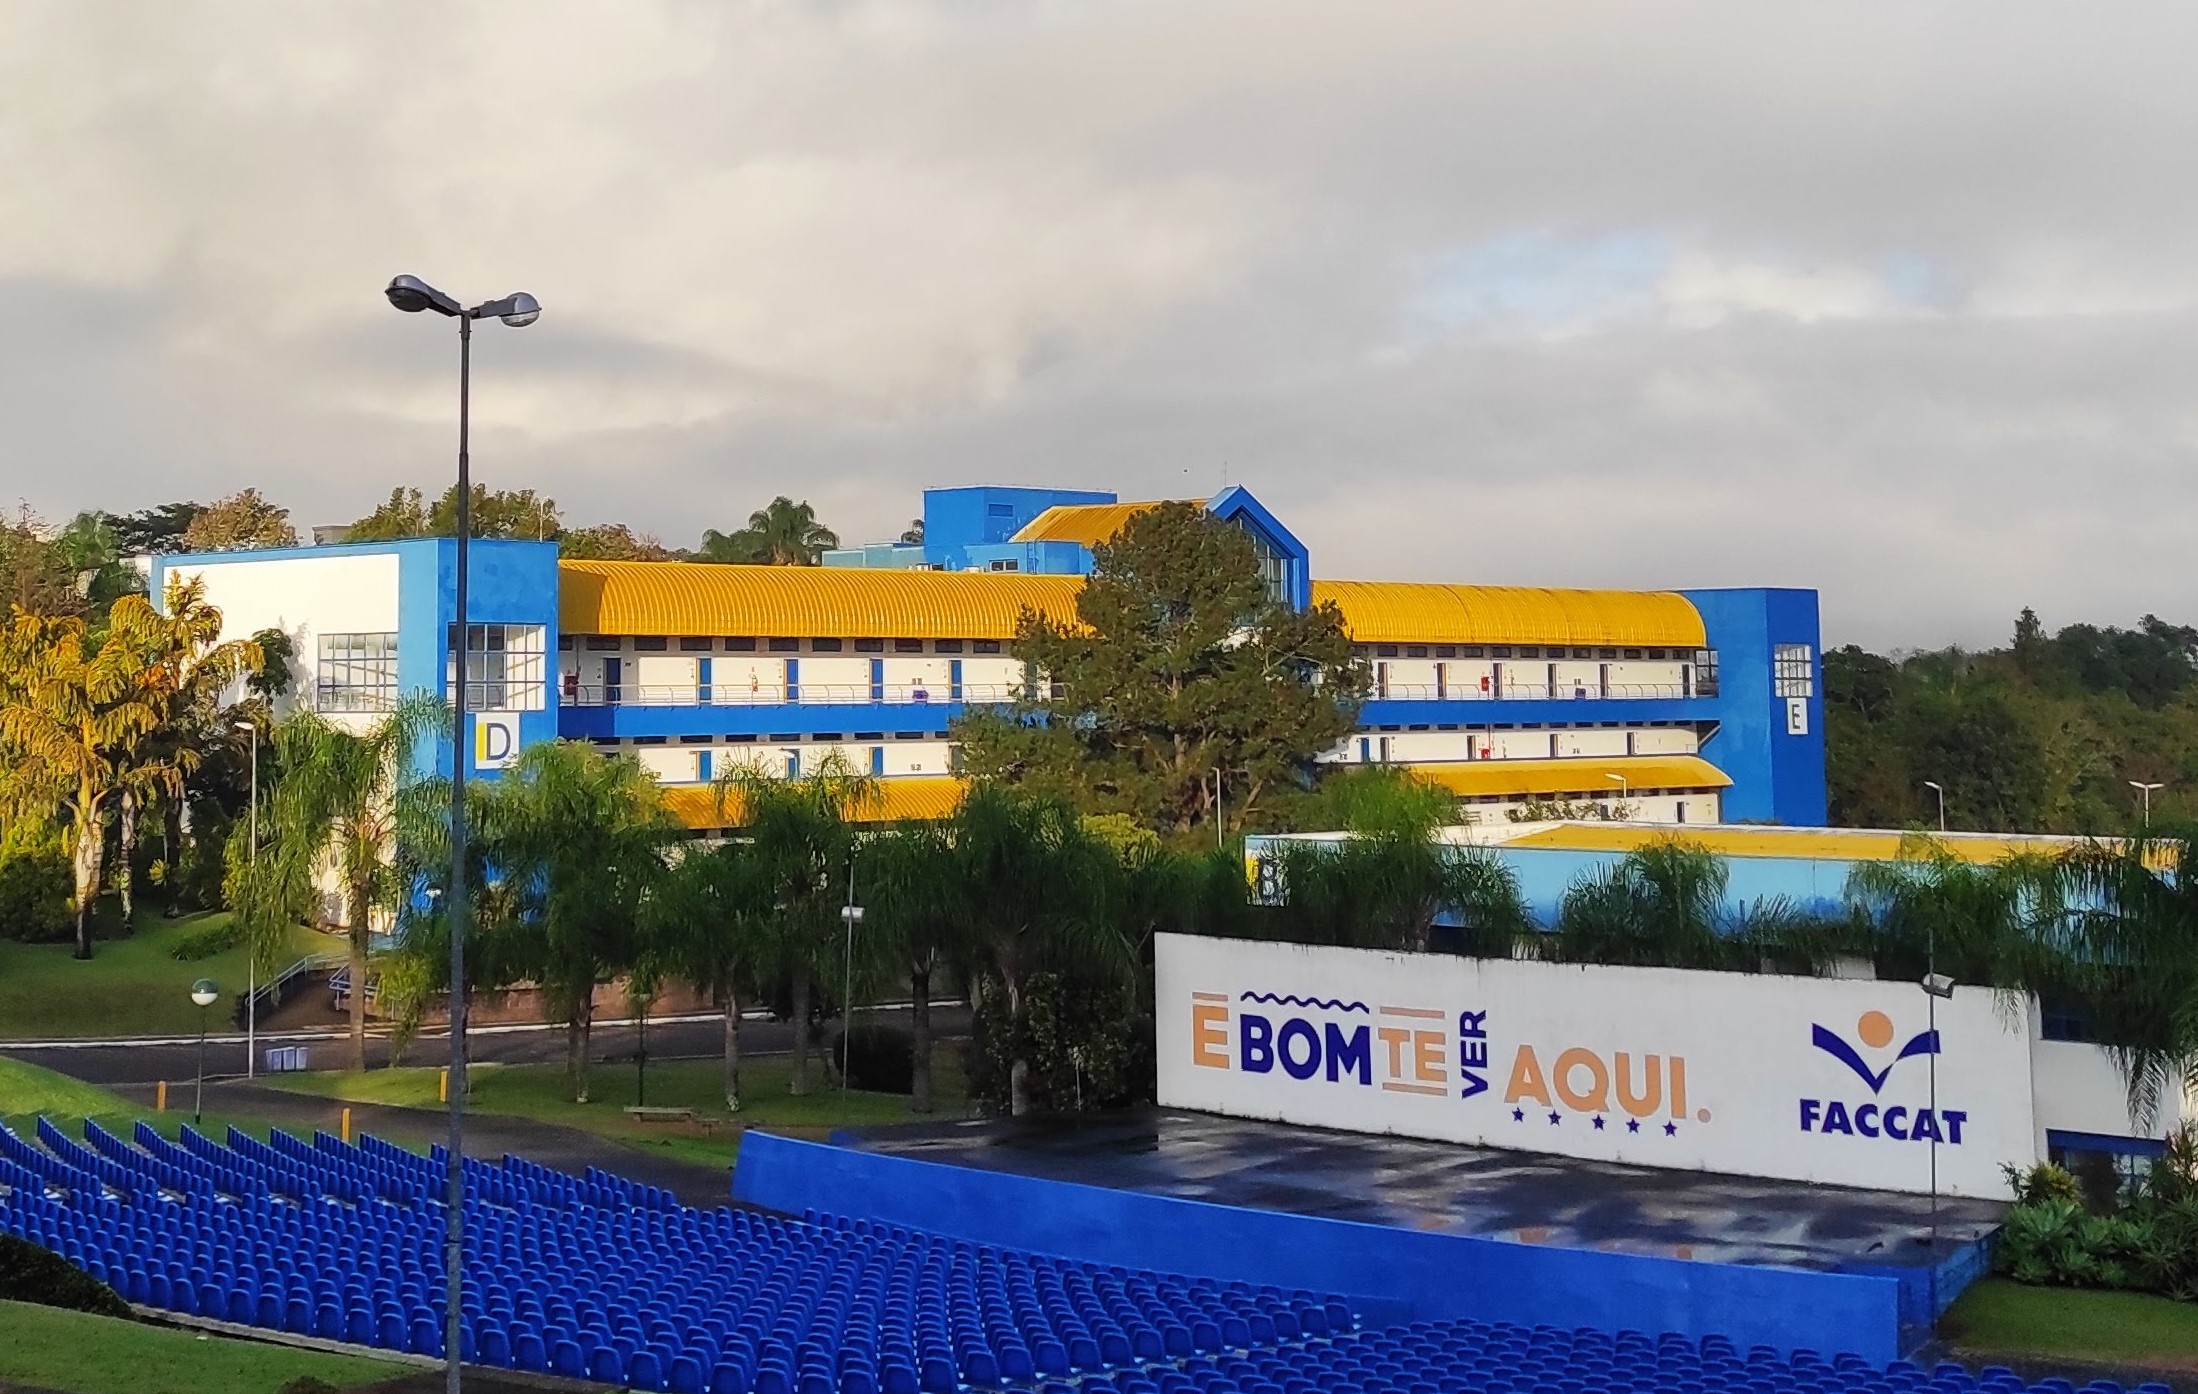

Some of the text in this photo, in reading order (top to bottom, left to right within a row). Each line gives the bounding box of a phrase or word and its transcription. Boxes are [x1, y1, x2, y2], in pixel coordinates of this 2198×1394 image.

[1792, 704, 1801, 729] E
[486, 723, 511, 760] D
[1240, 1013, 1372, 1085] BOM
[1378, 1027, 1447, 1082] TE
[1459, 1010, 1488, 1100] VER
[1800, 1098, 1967, 1145] FACCAT
